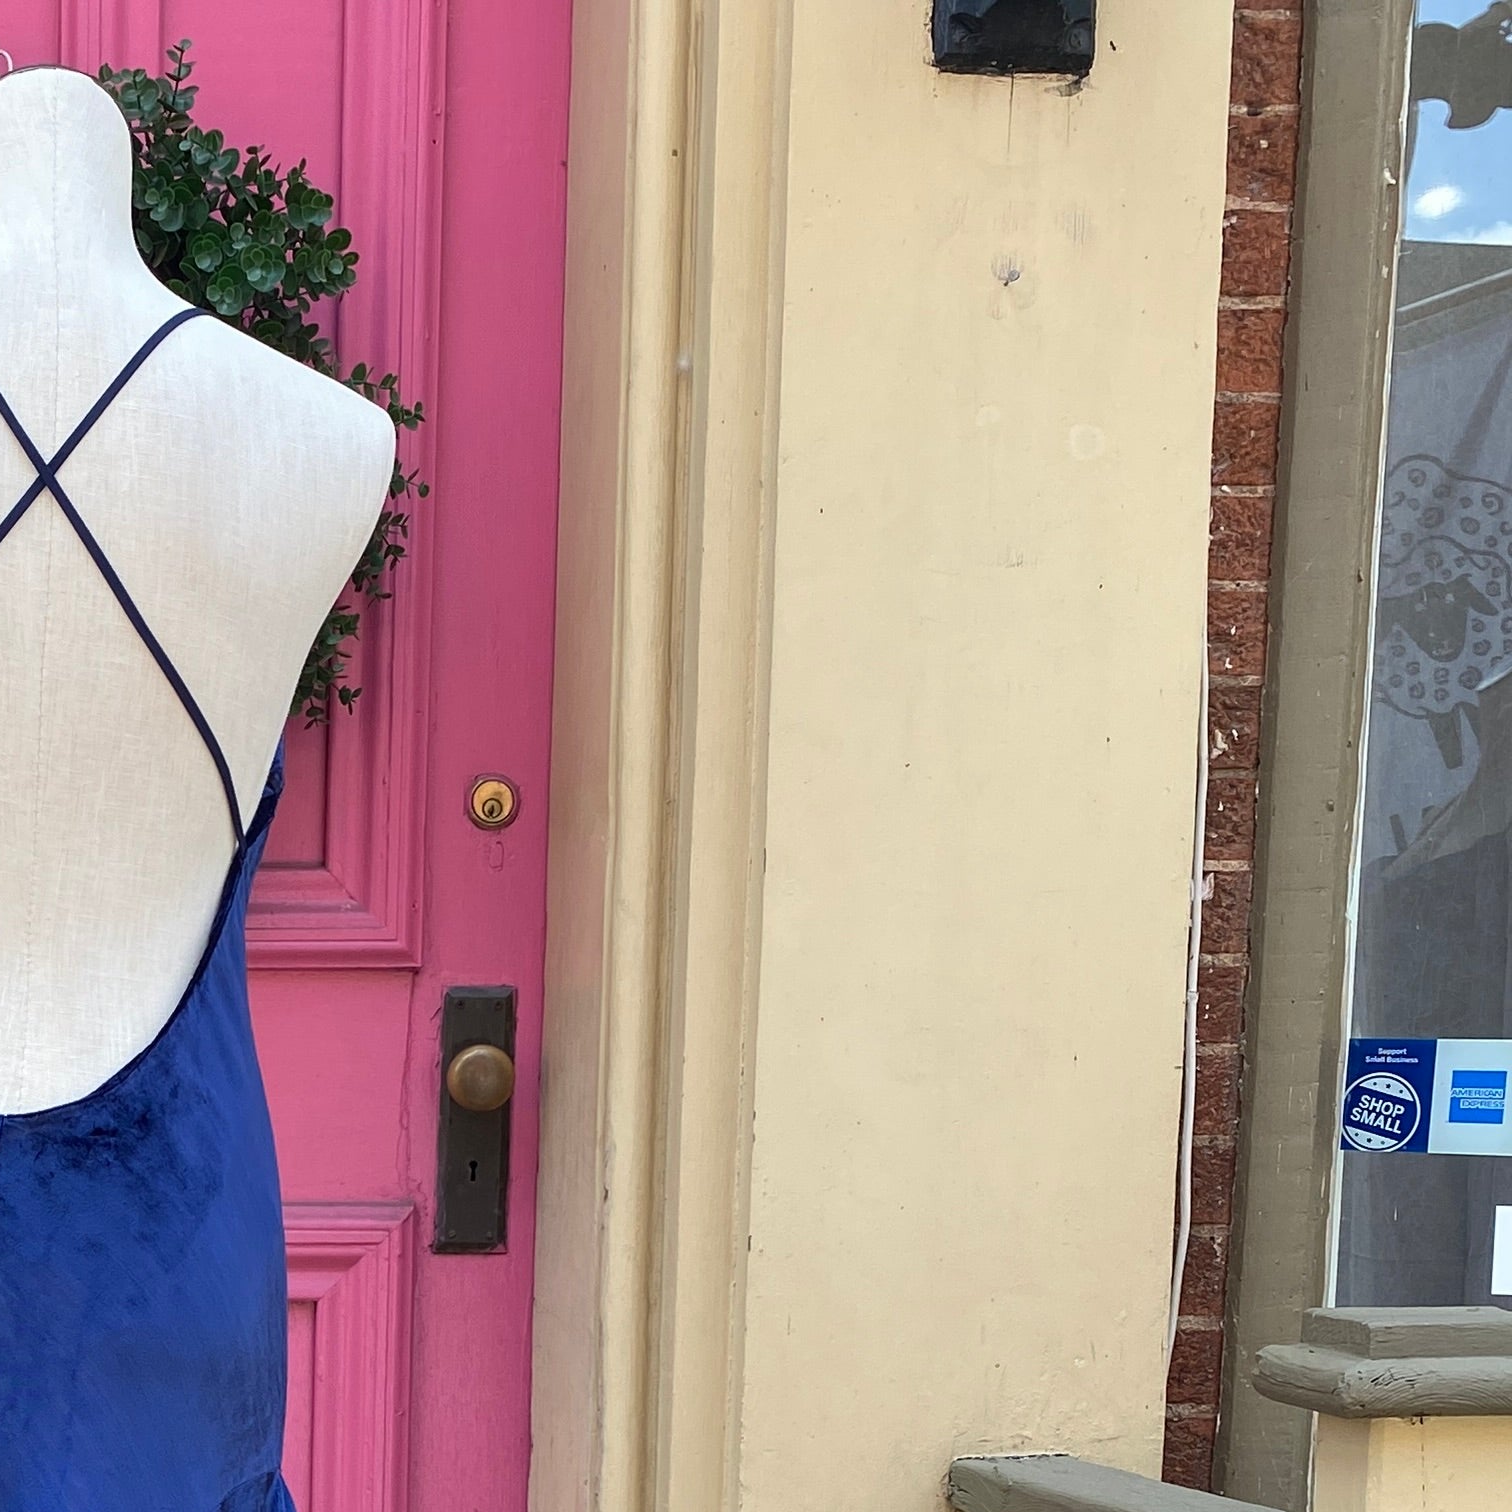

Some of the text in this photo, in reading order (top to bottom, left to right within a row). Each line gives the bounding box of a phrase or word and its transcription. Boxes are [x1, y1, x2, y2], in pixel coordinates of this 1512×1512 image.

[1378, 1047, 1407, 1056] Support
[1386, 1056, 1419, 1064] Business
[1451, 1089, 1503, 1097] AMERICAN
[1358, 1094, 1405, 1118] SHOP
[1461, 1100, 1505, 1108] EXPRESS
[1350, 1107, 1402, 1134] SMALL
